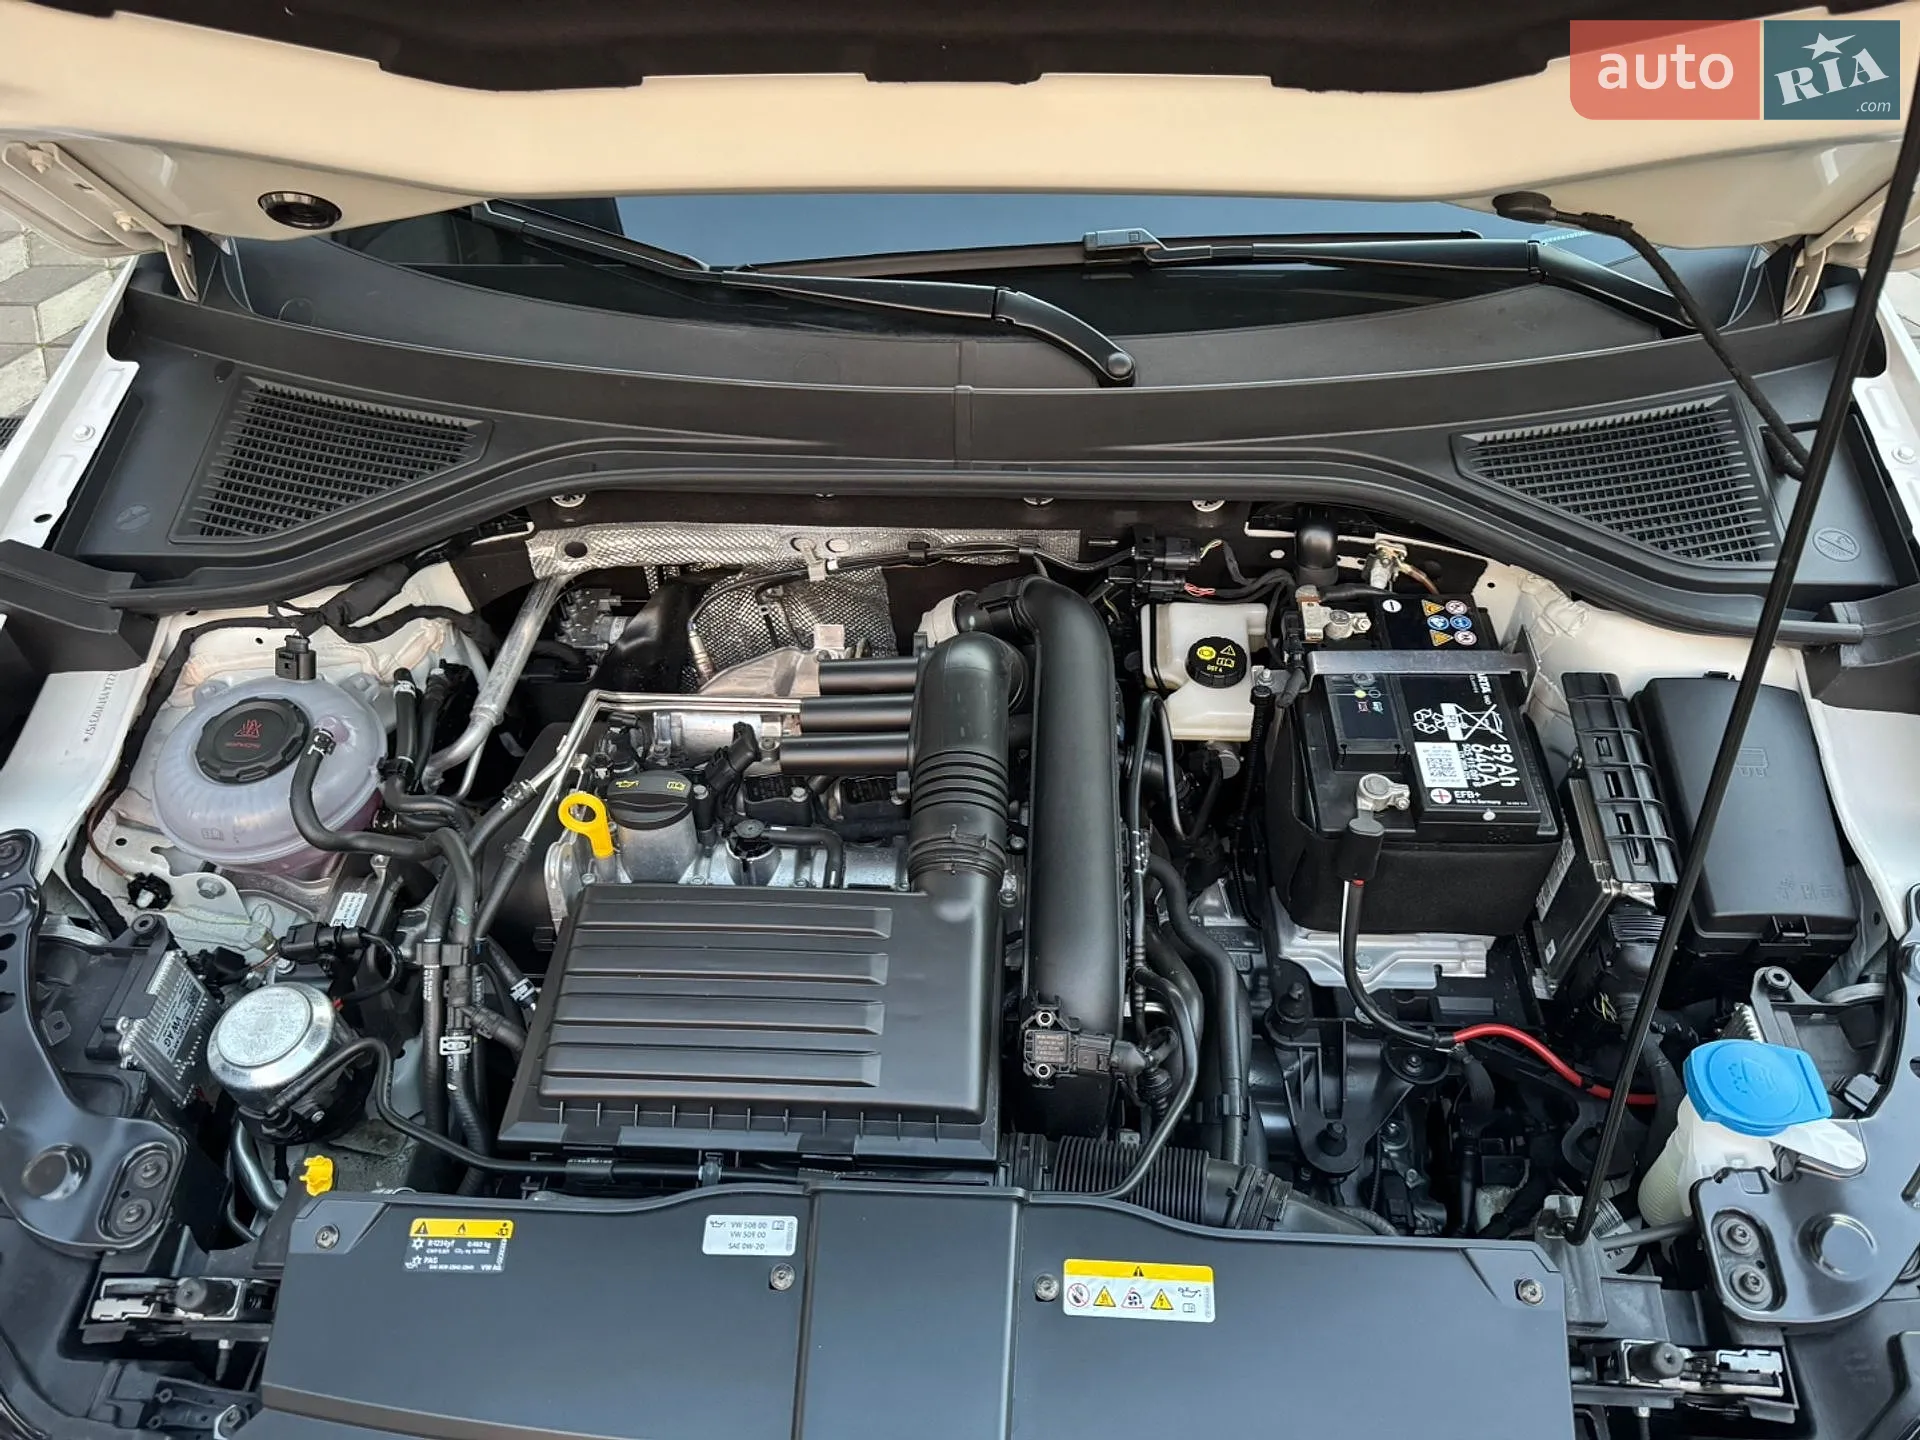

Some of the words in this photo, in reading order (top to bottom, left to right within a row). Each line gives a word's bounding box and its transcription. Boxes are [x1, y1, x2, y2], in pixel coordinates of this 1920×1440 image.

[1471, 743, 1500, 787] 640A
[1490, 743, 1520, 787] 59Ah
[1453, 790, 1482, 799] EFB+
